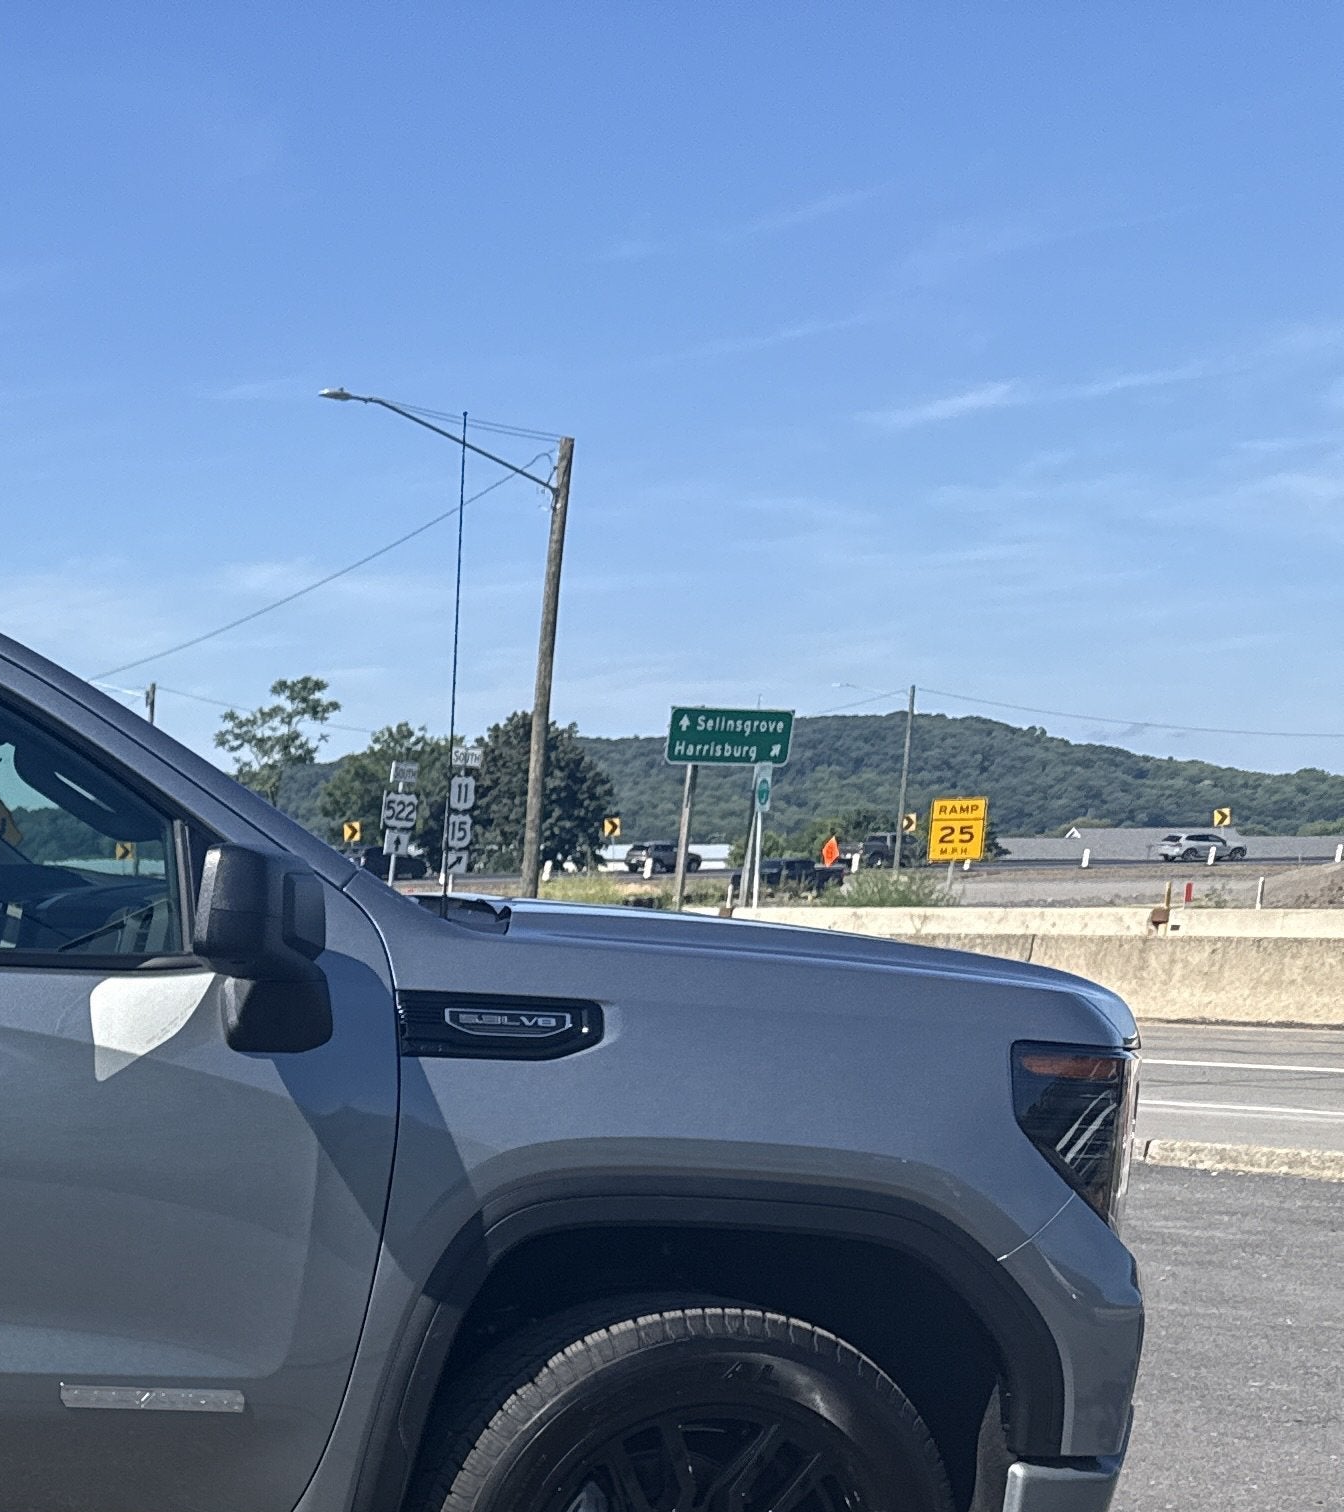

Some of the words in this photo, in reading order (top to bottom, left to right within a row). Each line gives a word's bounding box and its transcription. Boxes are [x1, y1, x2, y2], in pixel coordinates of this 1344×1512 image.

[696, 714, 785, 737] Selinsgrove
[453, 750, 482, 762] SOUTH
[673, 740, 758, 762] Harrisburg
[457, 783, 469, 804] 11
[385, 800, 416, 821] 522
[938, 804, 980, 816] RAMP
[450, 821, 467, 843] 15
[938, 825, 975, 844] 25
